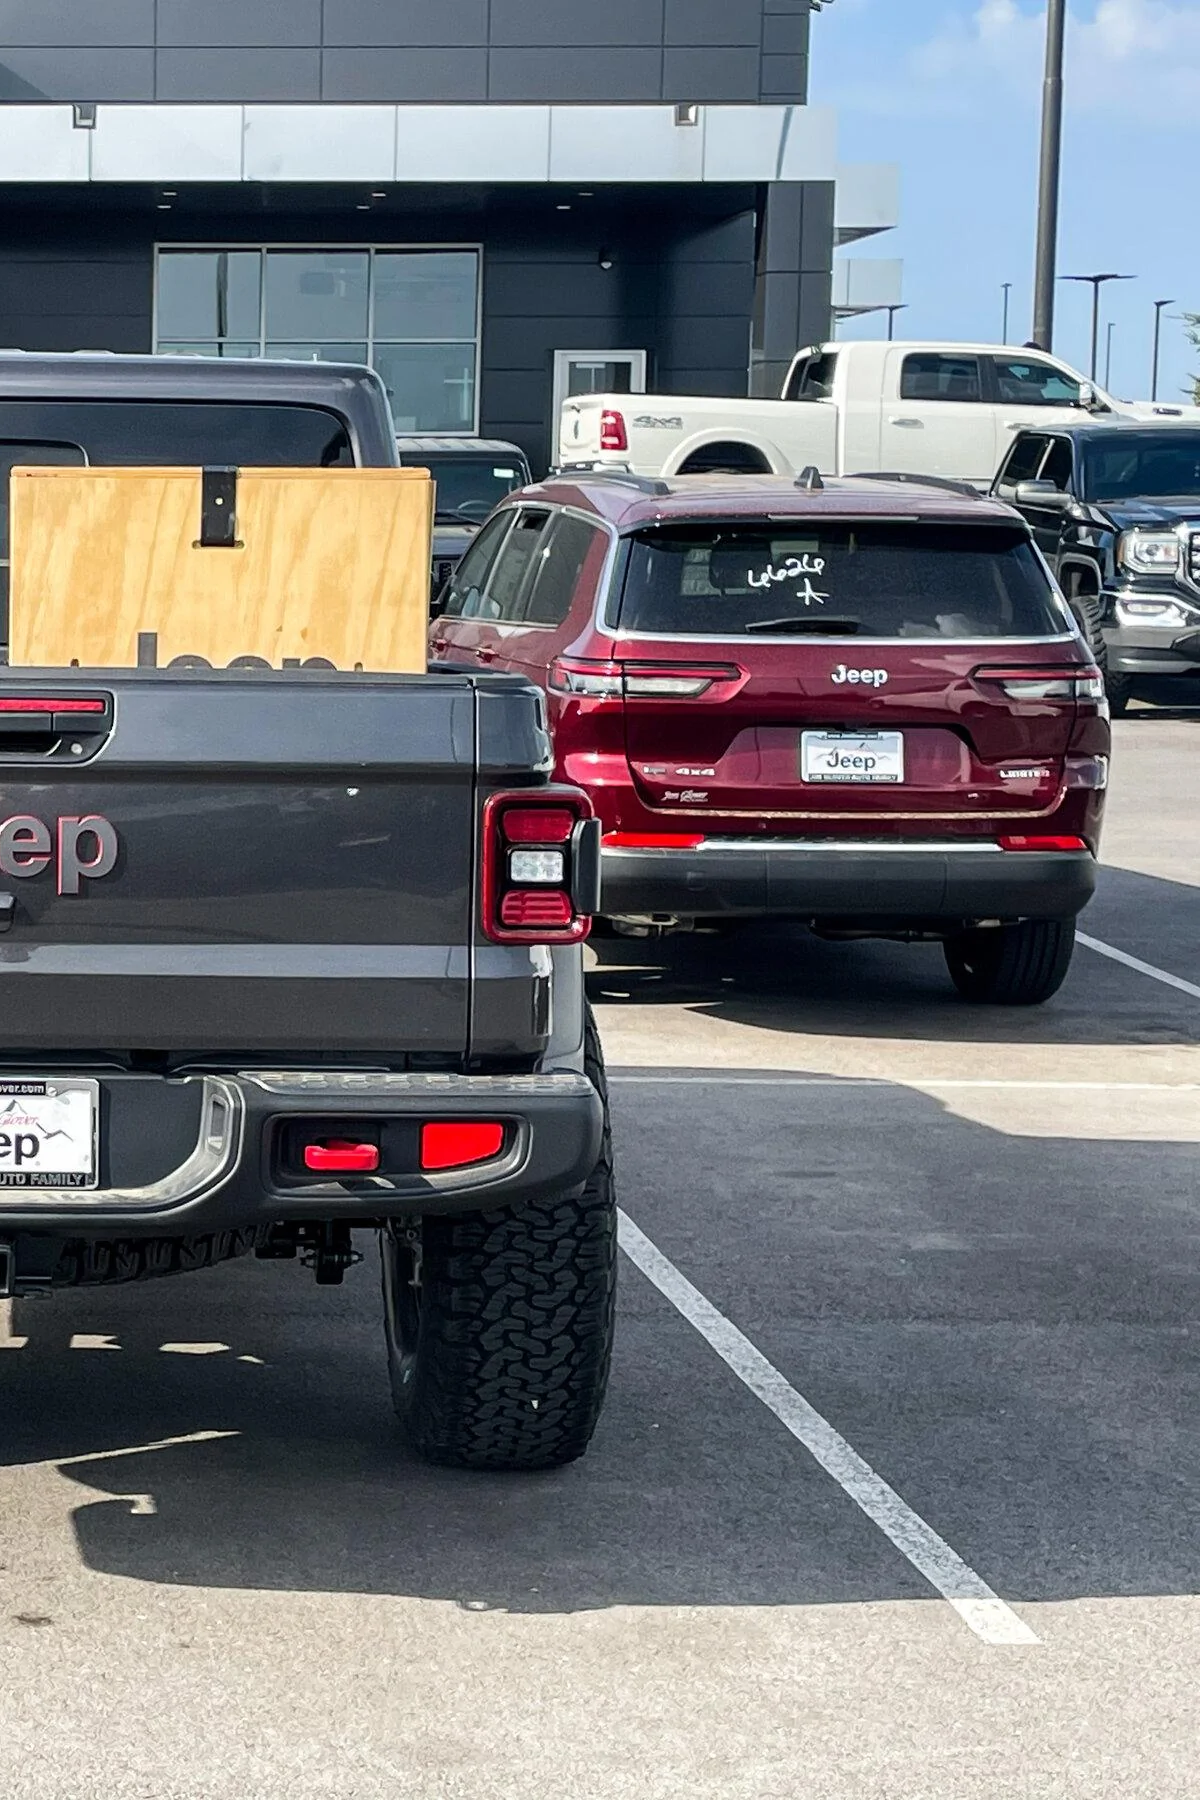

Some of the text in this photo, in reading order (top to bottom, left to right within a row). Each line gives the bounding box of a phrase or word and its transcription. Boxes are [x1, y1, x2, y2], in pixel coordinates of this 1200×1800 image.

[830, 664, 888, 687] Jeep
[827, 752, 876, 771] Jeep
[29, 1173, 85, 1186] FAMILY
